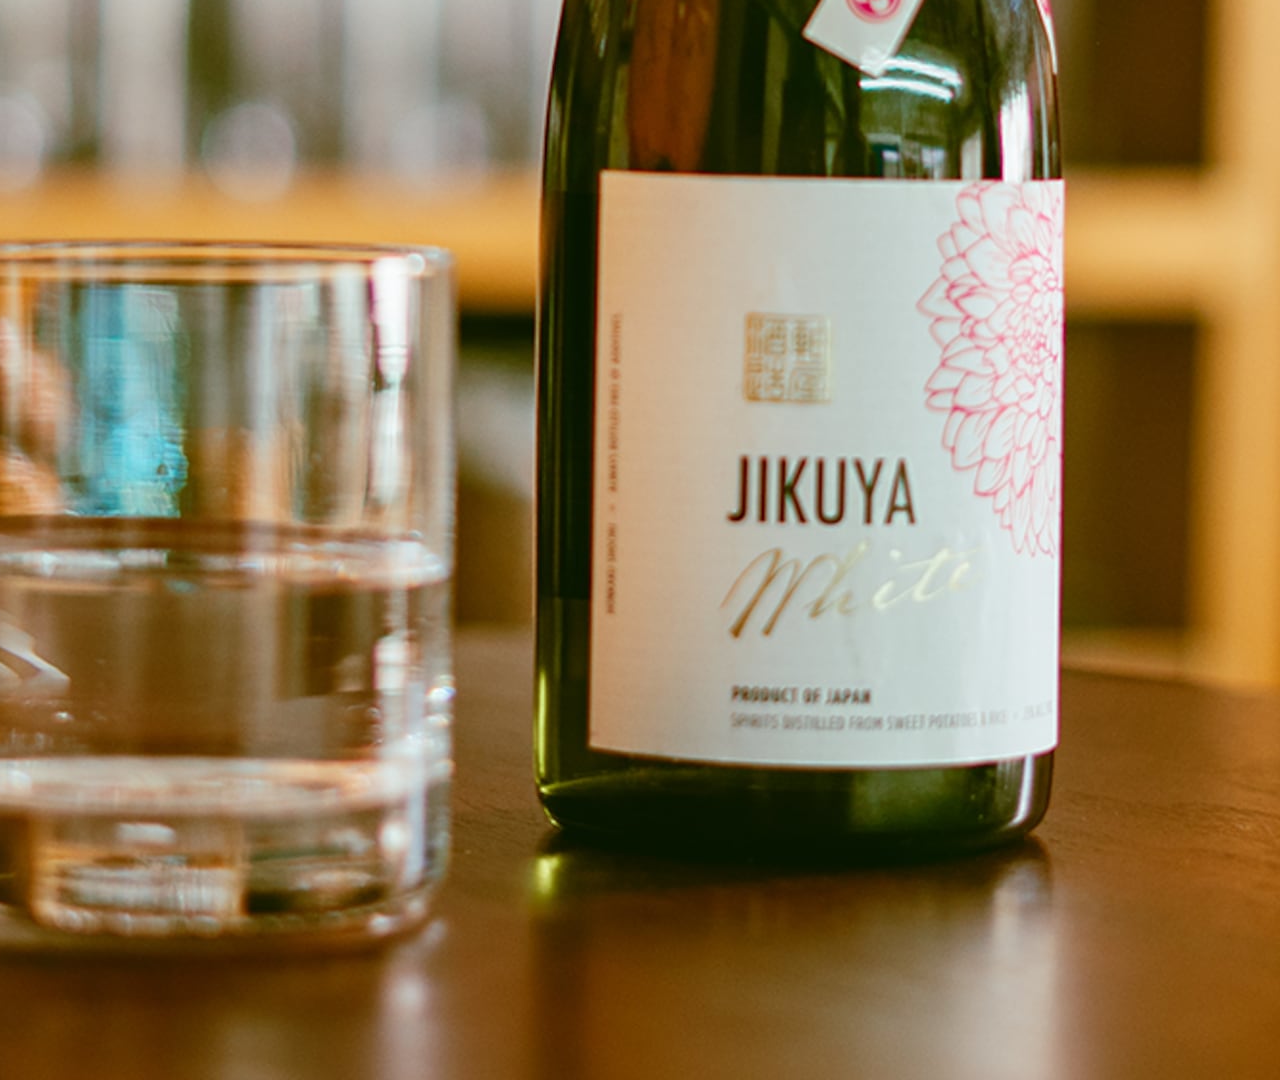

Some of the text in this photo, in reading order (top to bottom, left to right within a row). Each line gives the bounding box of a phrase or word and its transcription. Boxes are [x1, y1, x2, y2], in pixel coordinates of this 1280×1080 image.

[726, 454, 917, 526] JIKUYA
[720, 538, 981, 639] White
[731, 684, 873, 705] PRODUCT OF JAPAN
[730, 712, 779, 730] SPIRITS
[782, 713, 845, 731] DISTILLED
[849, 714, 883, 731] FROM
[886, 713, 926, 731] SWEET
